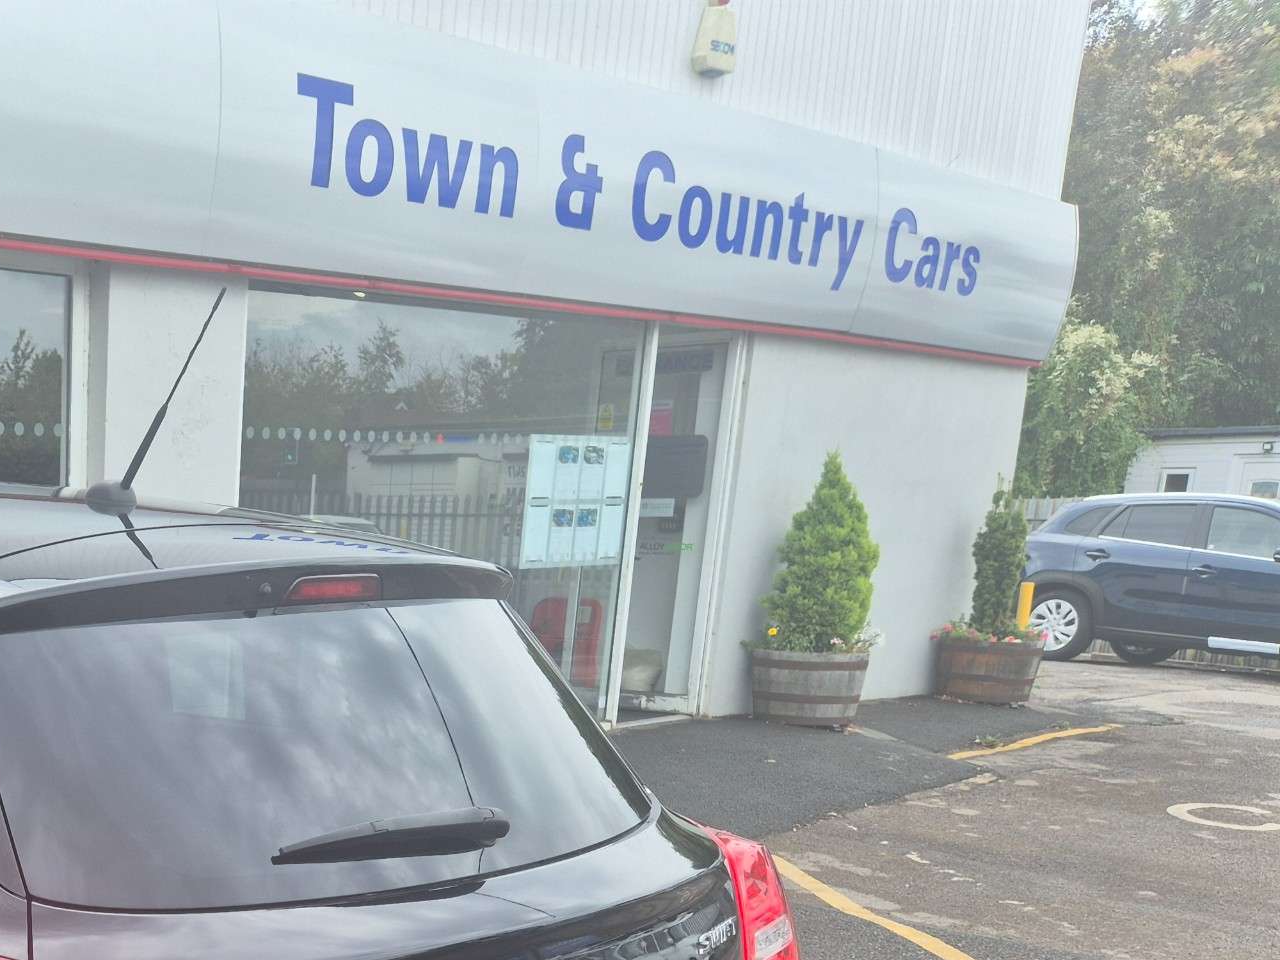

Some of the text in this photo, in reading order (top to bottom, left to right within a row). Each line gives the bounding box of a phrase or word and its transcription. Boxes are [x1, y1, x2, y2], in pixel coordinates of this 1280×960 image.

[297, 72, 980, 296] Town & Country Cars
